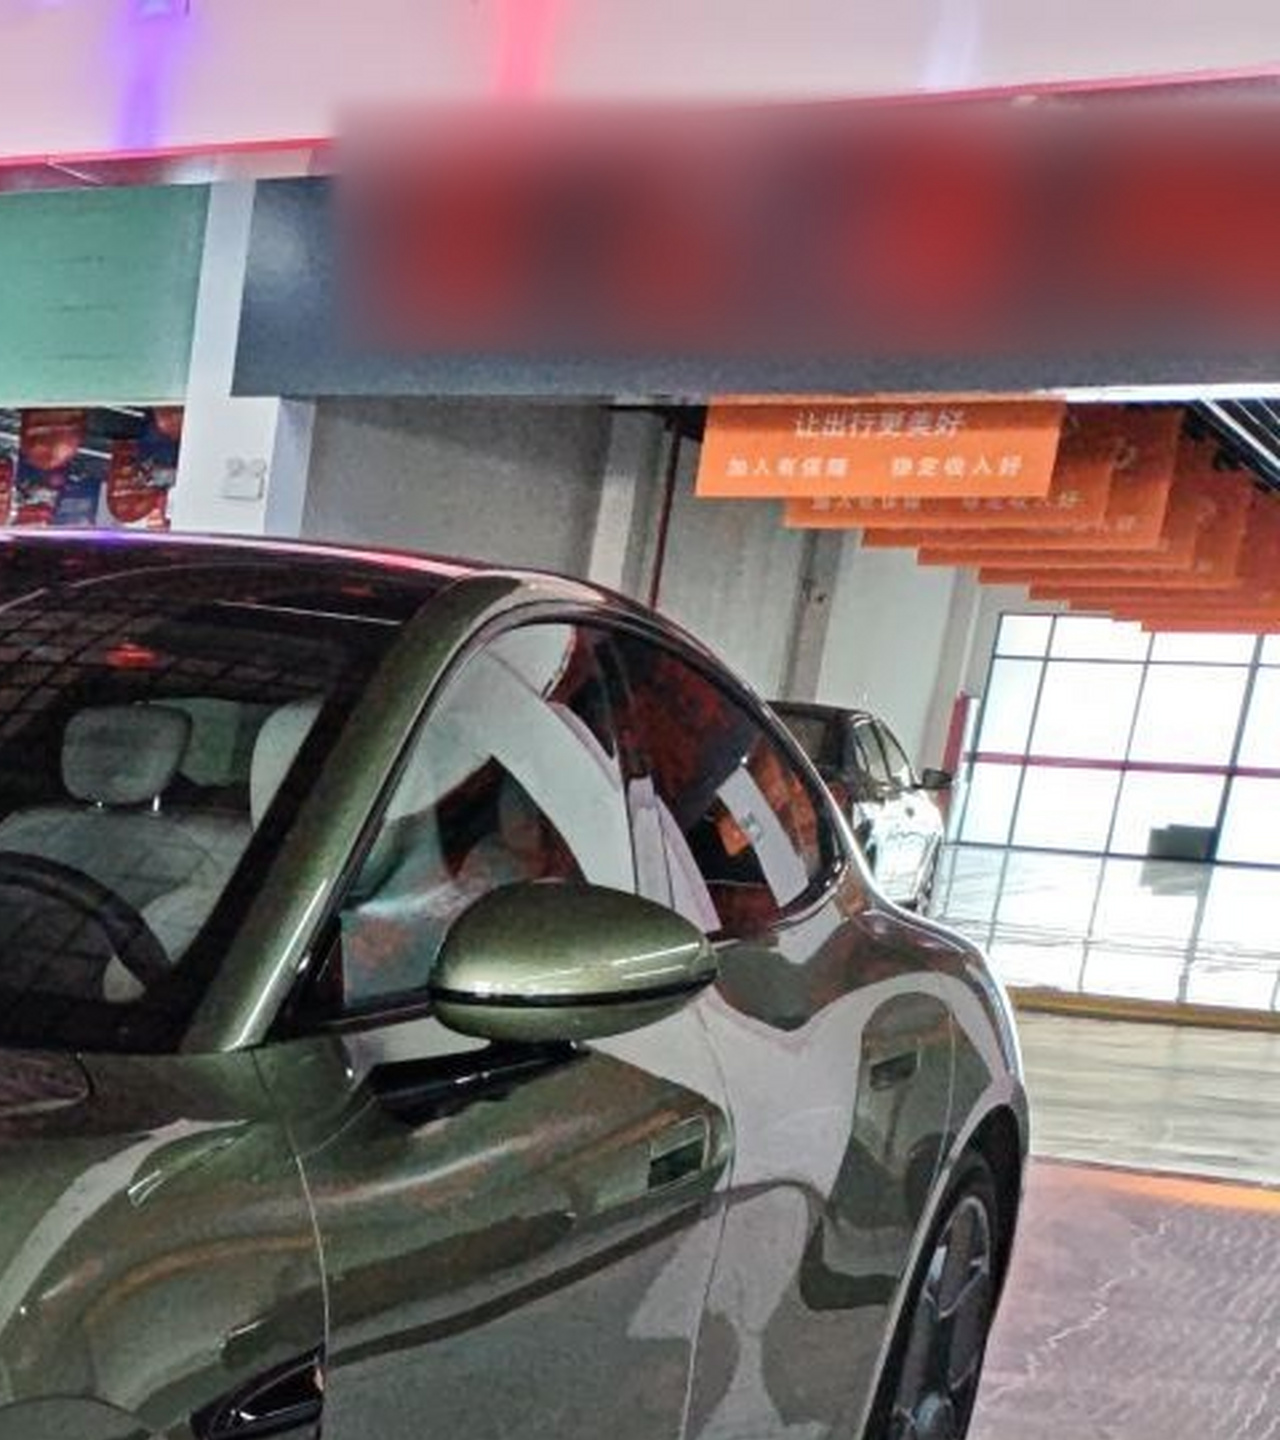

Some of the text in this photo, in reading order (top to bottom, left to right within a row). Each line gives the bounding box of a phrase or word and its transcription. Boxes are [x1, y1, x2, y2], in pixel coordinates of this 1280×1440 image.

[795, 410, 966, 438] 让出行更美好
